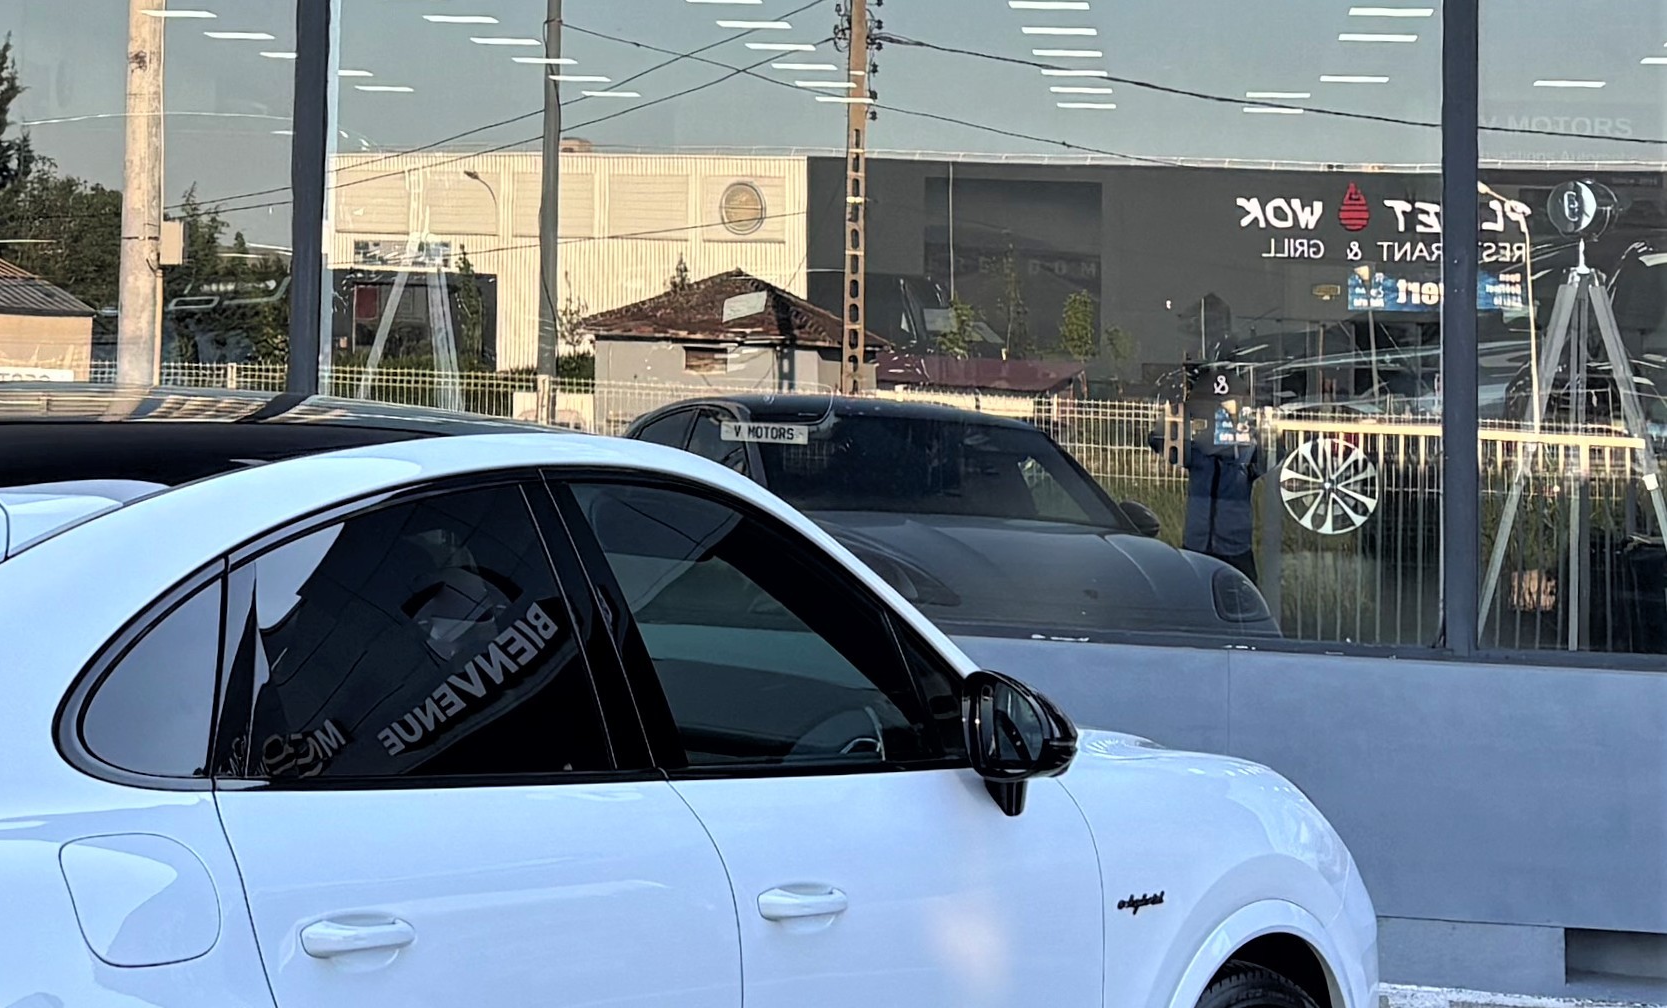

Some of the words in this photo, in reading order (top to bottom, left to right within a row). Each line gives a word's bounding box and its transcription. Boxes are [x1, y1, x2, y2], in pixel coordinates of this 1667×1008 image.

[1507, 115, 1633, 137] MOTORS
[734, 425, 742, 438] V
[747, 426, 795, 441] MOTORS
